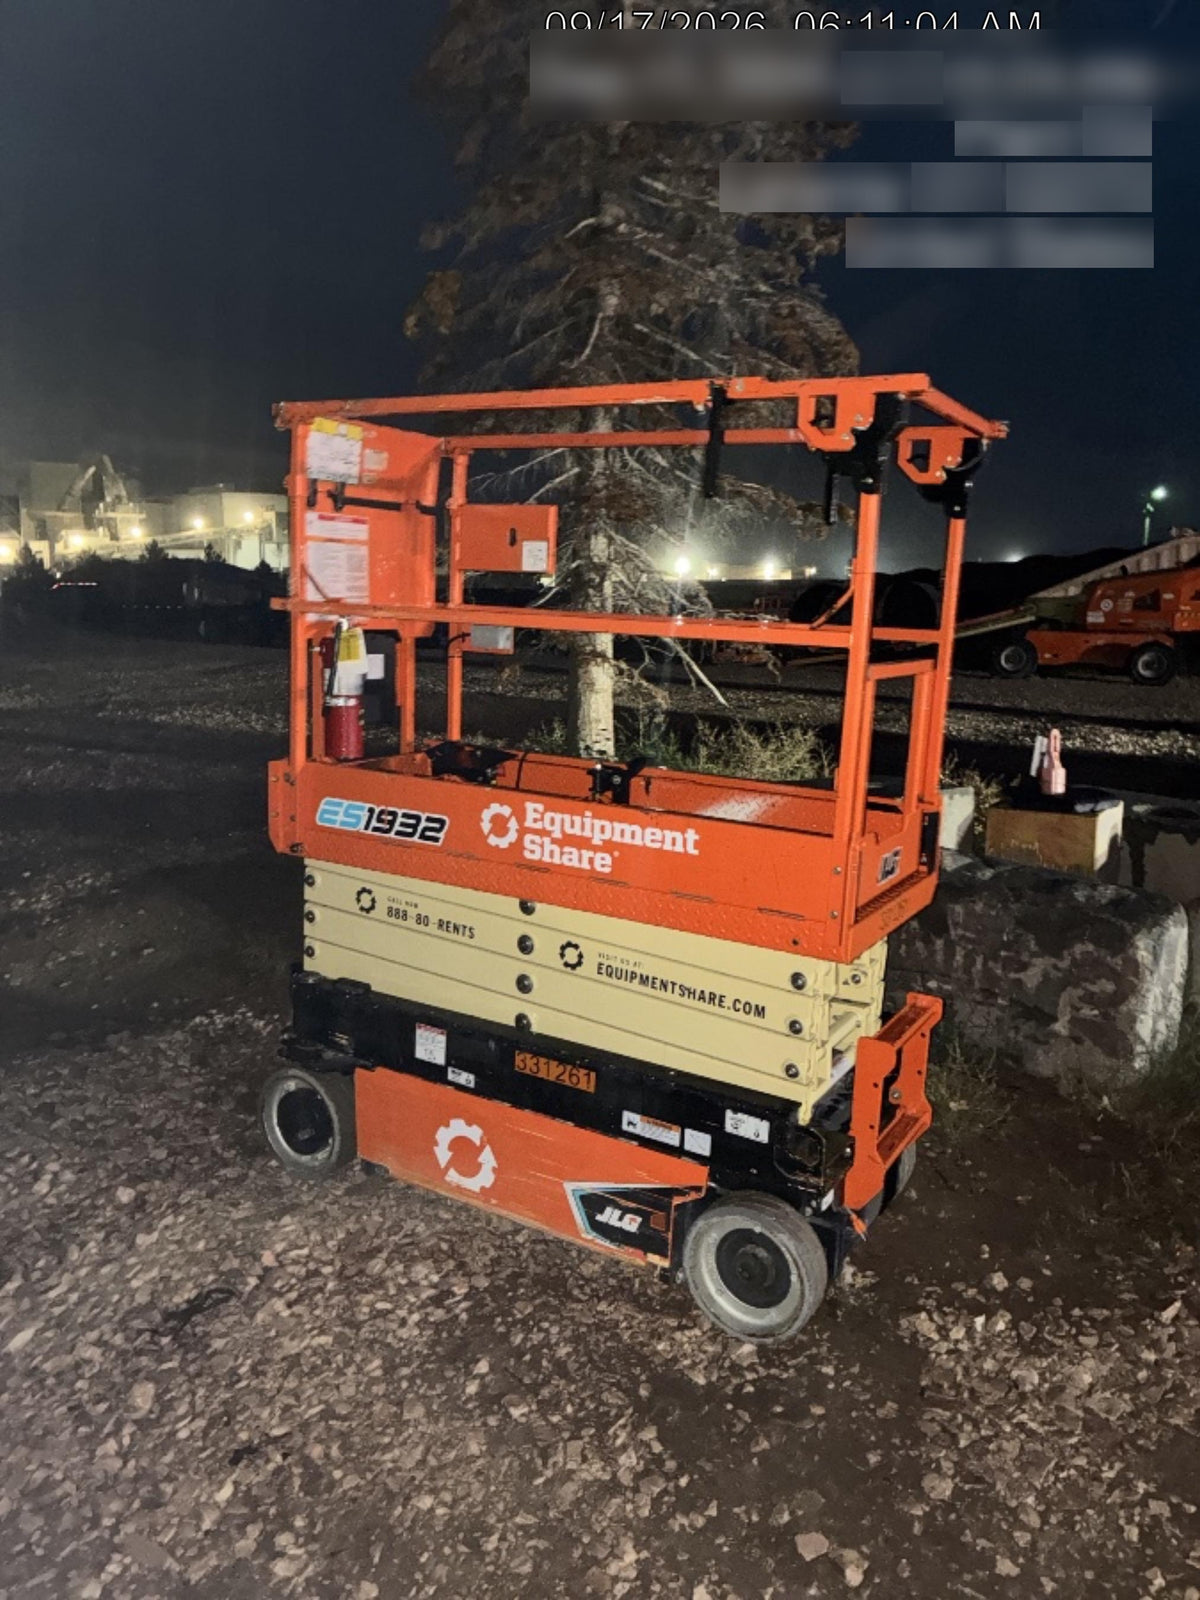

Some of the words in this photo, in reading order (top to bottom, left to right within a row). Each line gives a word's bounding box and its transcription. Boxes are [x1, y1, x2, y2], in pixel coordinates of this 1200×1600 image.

[317, 797, 448, 845] ES1932
[524, 801, 699, 855] Equipment
[596, 962, 766, 1019] EQUIPMENTSHARE.COM
[516, 1052, 592, 1090] 331261
[594, 1206, 643, 1233] JLG
